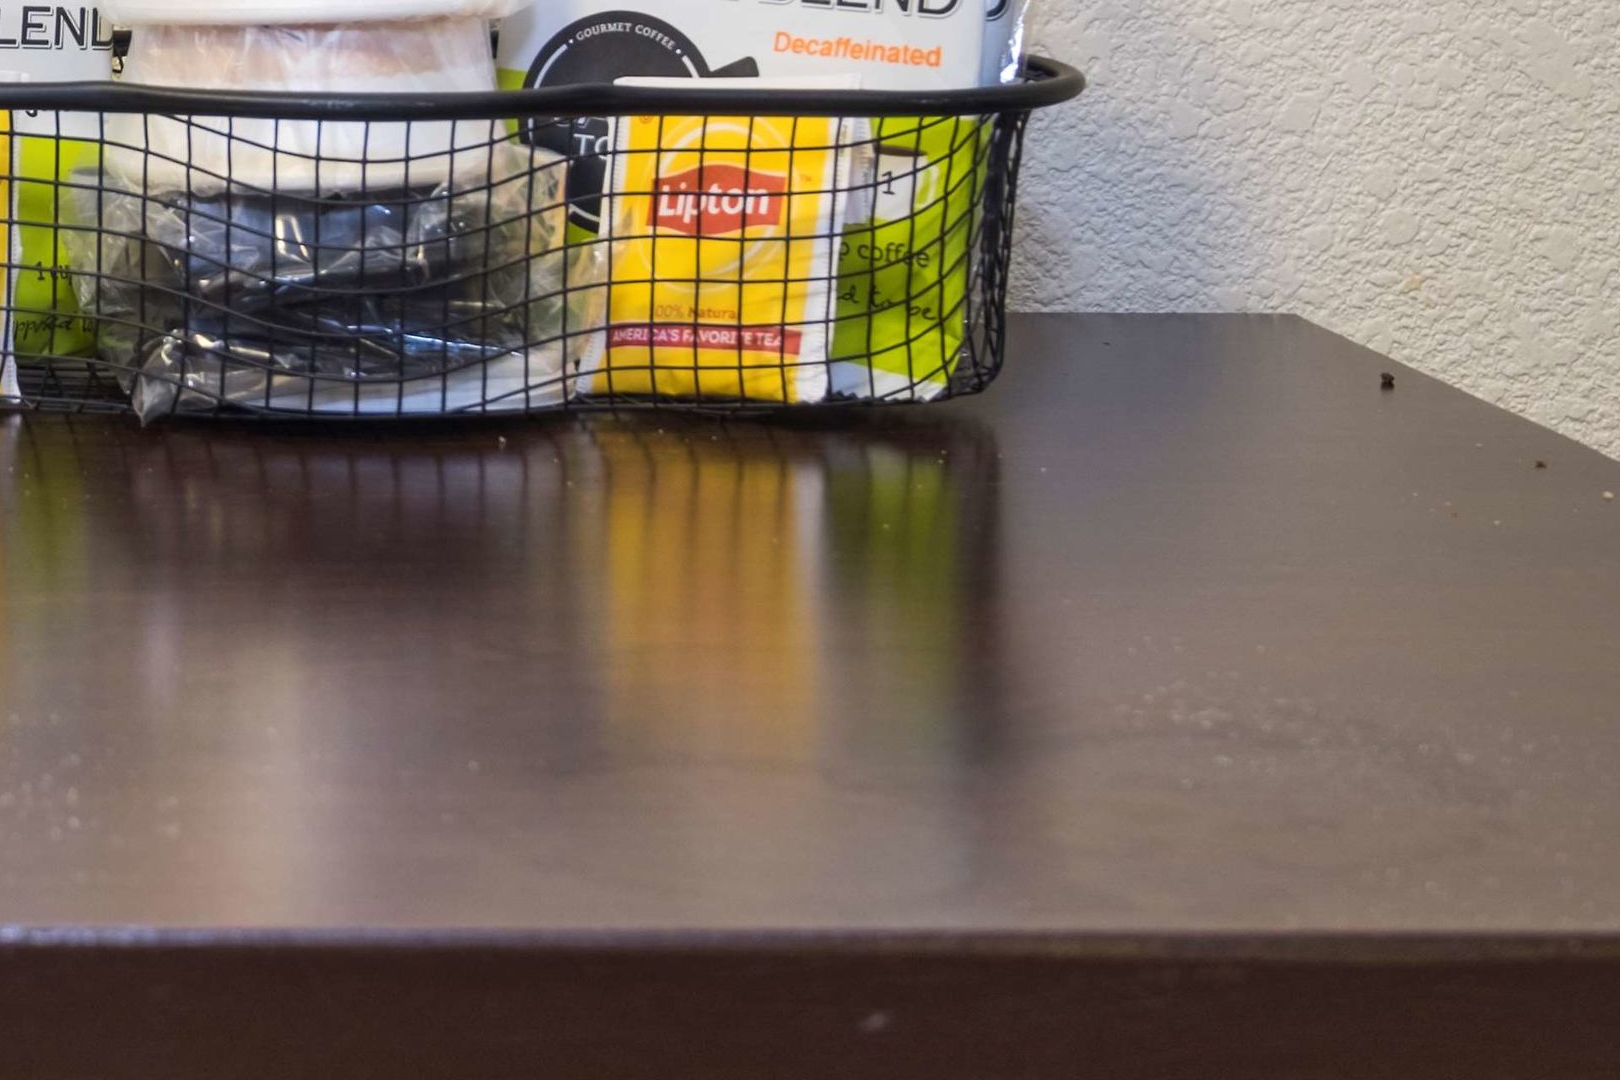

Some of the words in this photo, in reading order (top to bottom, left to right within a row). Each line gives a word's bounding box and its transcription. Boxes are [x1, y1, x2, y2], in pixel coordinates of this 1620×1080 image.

[576, 22, 632, 41] GOURMET
[634, 24, 676, 50] COFFEE
[773, 31, 942, 68] Decaffeinated
